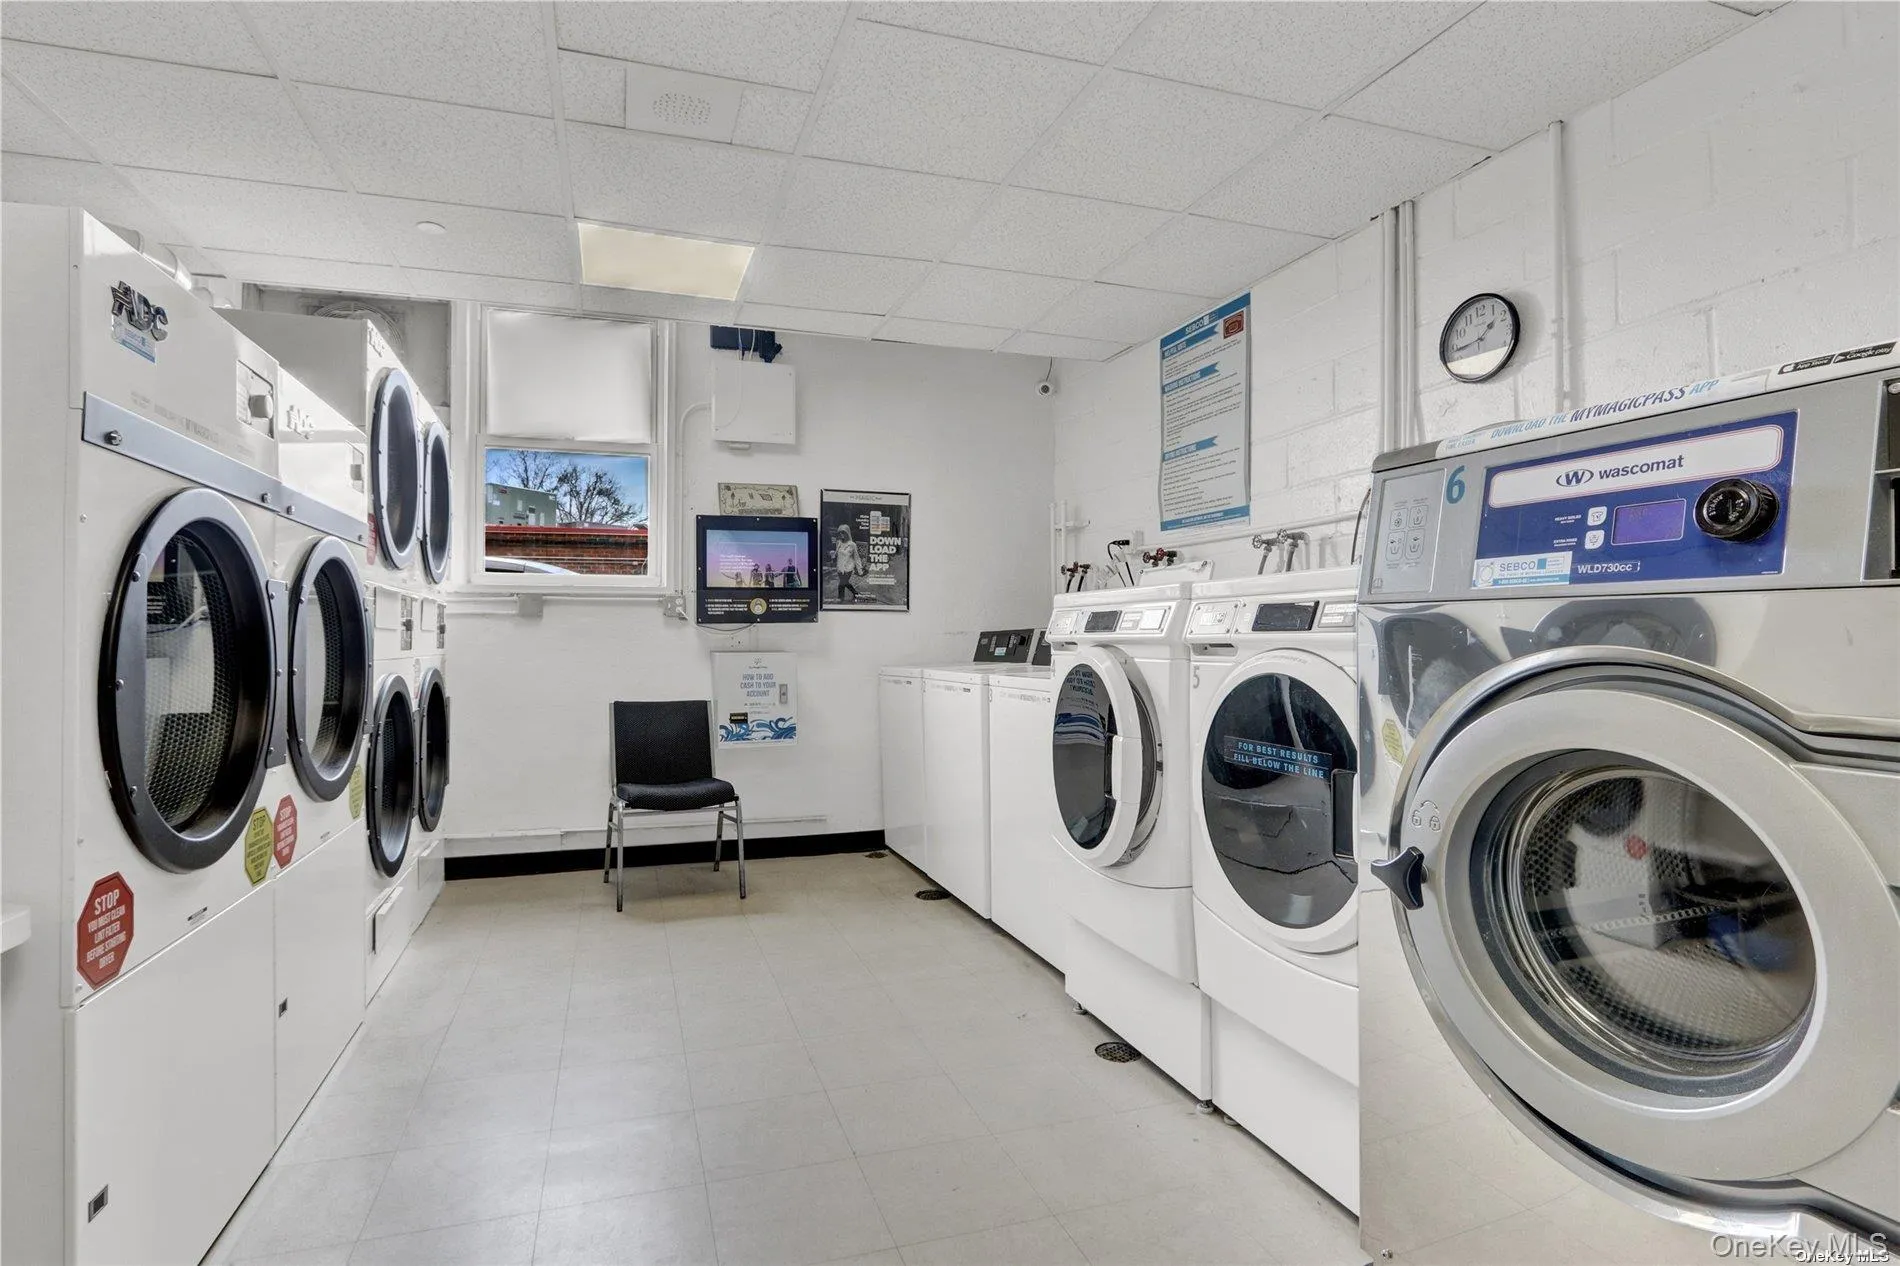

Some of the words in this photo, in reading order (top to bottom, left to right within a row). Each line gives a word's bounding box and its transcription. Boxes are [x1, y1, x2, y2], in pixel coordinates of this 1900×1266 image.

[1475, 304, 1486, 318] 12
[1490, 304, 1495, 316] 1
[1464, 314, 1473, 327] 11
[1455, 328, 1466, 340] 10
[1846, 350, 1875, 360] Google
[1875, 346, 1892, 356] play
[1491, 418, 1547, 438] DOWNLOAD
[1548, 412, 1568, 426] THE
[1570, 386, 1687, 422] MYMAGICPASS
[1689, 379, 1719, 395] APP
[1598, 455, 1684, 479] wascomat
[1446, 465, 1465, 504] 6
[869, 536, 902, 546] DOWN
[869, 545, 897, 554] LOAD
[869, 554, 889, 563] THE
[869, 563, 890, 571] APP
[1499, 561, 1536, 572] SEBCO
[1577, 562, 1633, 574] WLD730cc
[742, 673, 755, 681] HOW
[755, 673, 763, 681] TO
[763, 673, 774, 681] ADD
[1192, 666, 1200, 688] 5
[762, 681, 776, 689] YOUR
[746, 689, 770, 697] ACCOUNT
[1238, 742, 1254, 752] FOR
[1256, 745, 1277, 755] BEST
[1280, 749, 1319, 763] RESULTS
[1233, 753, 1250, 763] FILL
[1252, 757, 1281, 770] BELOW
[1283, 763, 1300, 774] THE
[1303, 767, 1324, 779] LINE
[253, 815, 266, 831] STOP
[94, 888, 120, 915] STOP
